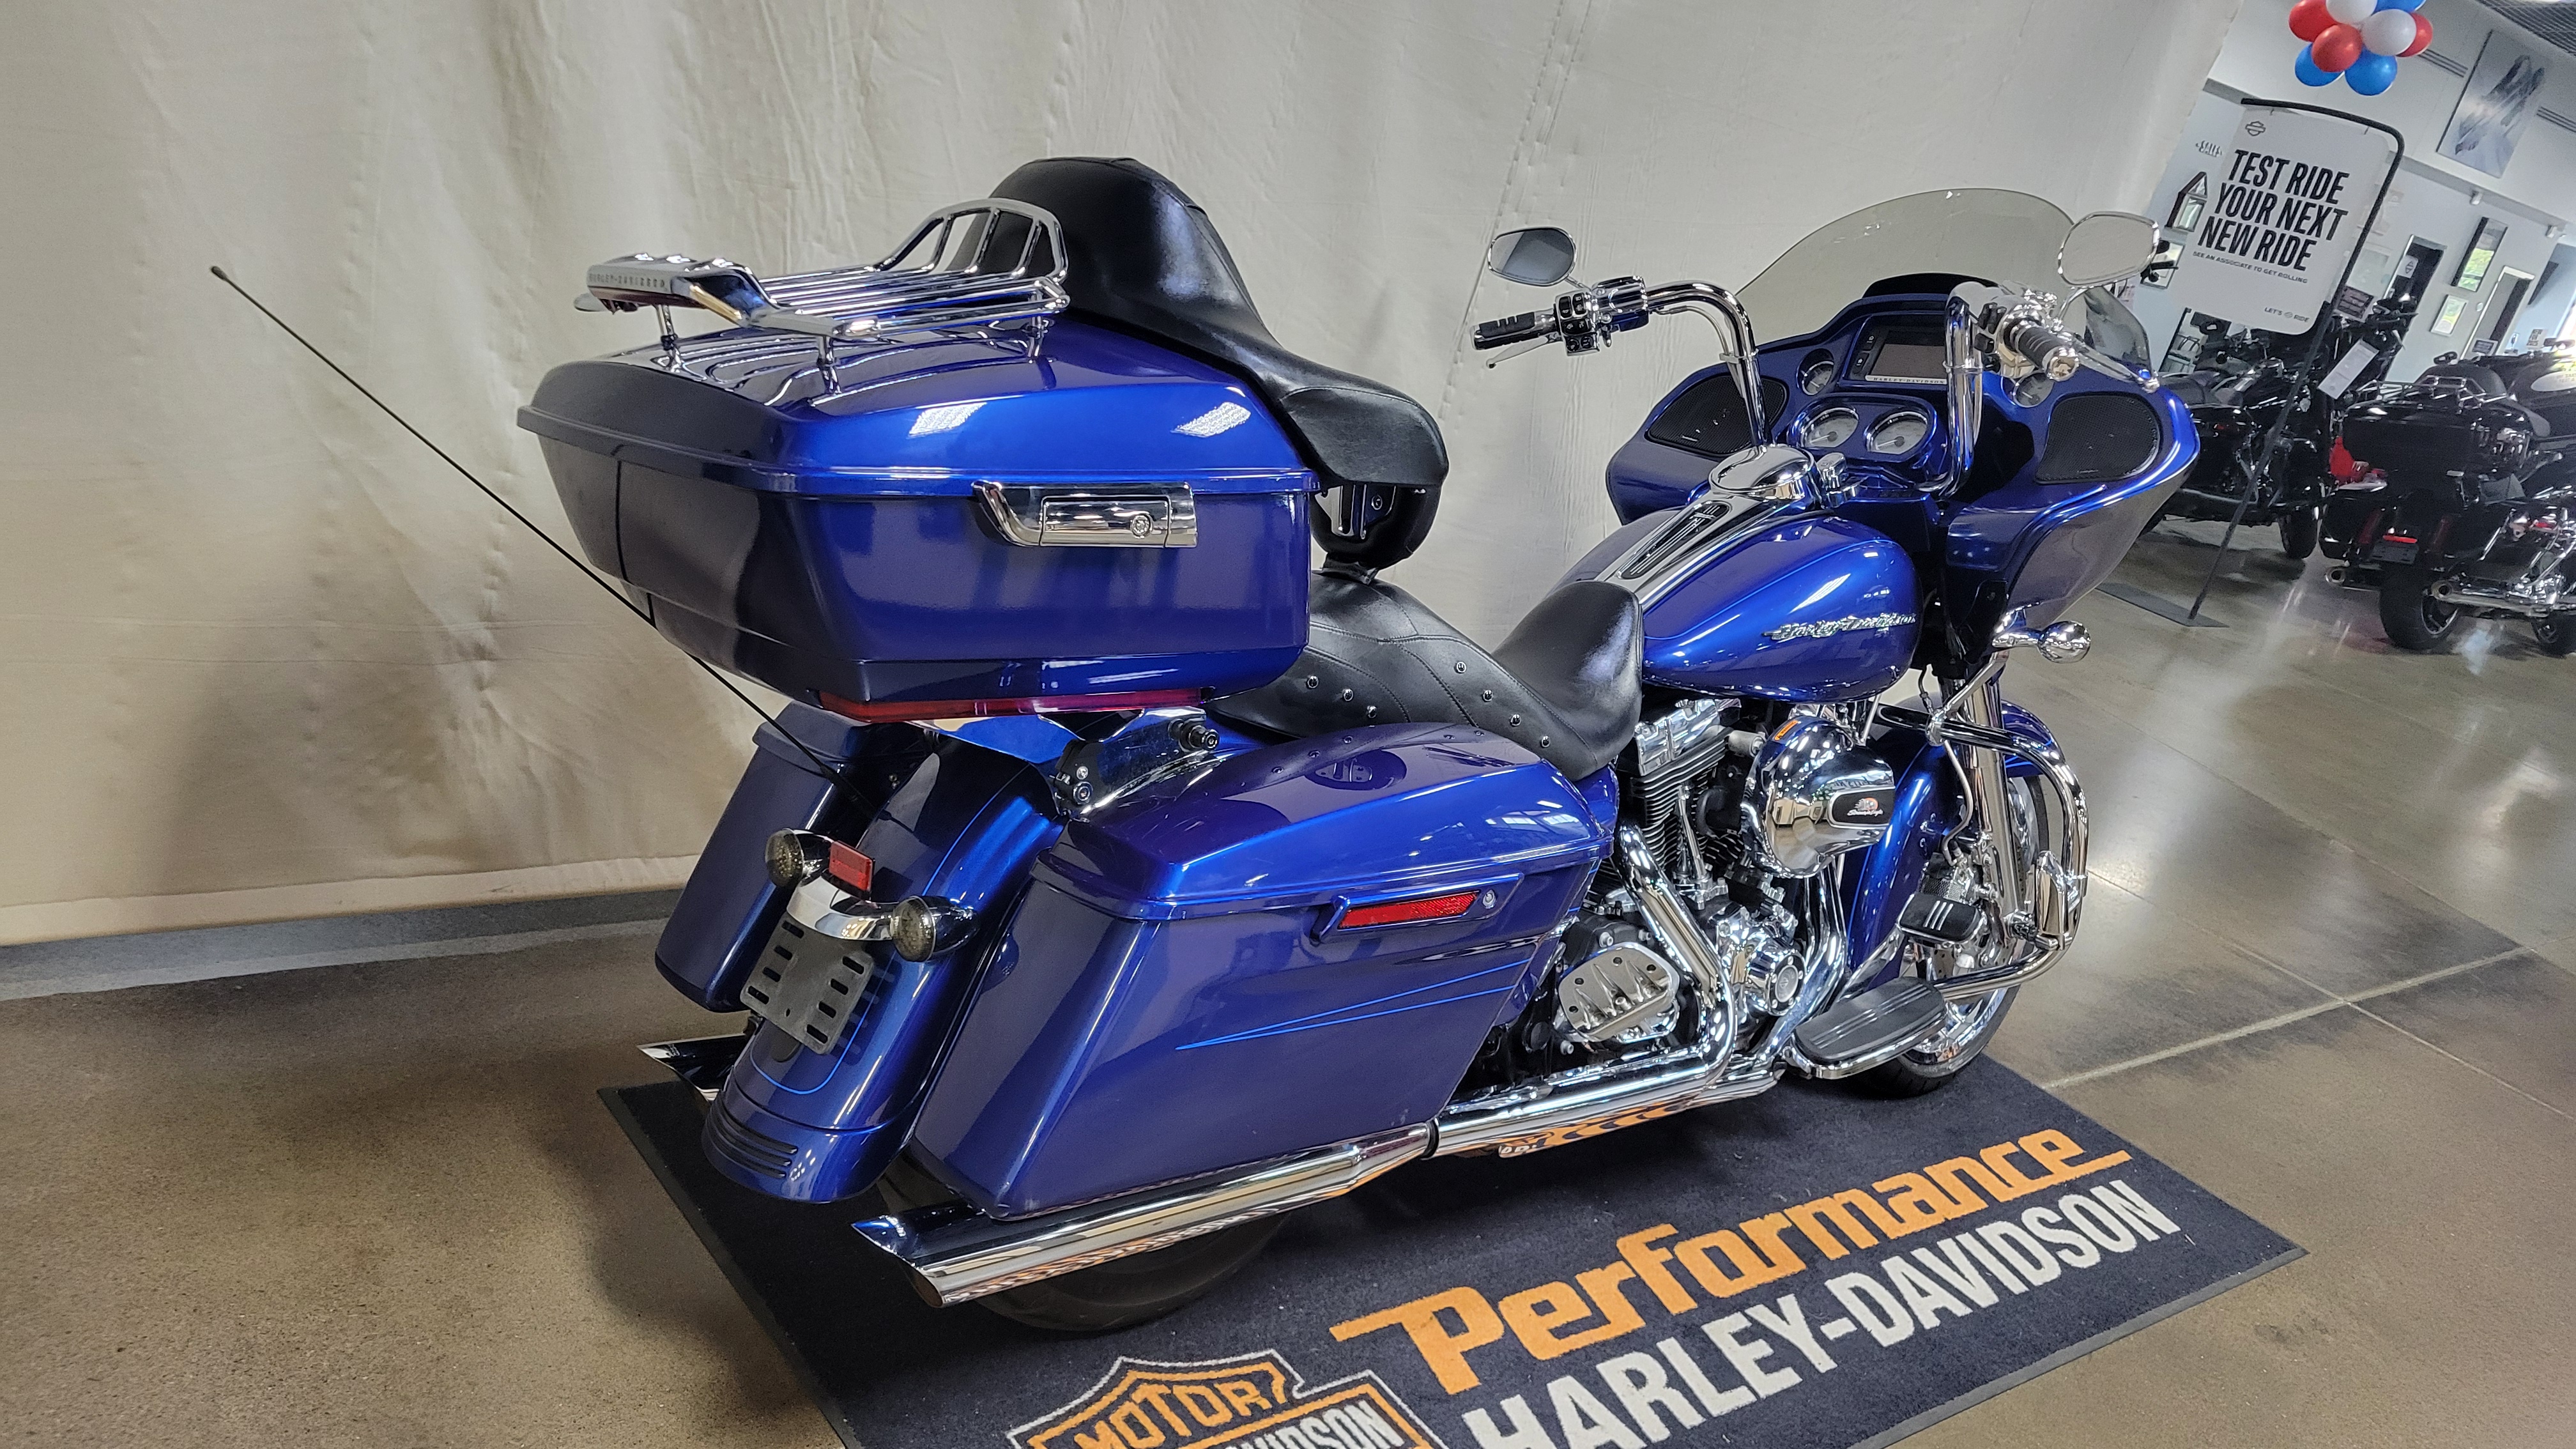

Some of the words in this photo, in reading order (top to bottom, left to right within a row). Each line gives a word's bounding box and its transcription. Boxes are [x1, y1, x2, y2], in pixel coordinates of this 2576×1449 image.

[2228, 149, 2290, 190] TEST
[2285, 162, 2350, 205] RIDE
[2214, 182, 2278, 226] YOUR
[2275, 197, 2349, 241] NEXT
[2198, 216, 2259, 256] NEW
[2253, 229, 2317, 271] RIDE
[2216, 257, 2252, 270] ASSOCIATE
[2278, 272, 2308, 284] ROLLING
[1328, 1128, 2133, 1393] Performance
[1461, 1179, 2181, 1449] HARLEY-DAVIDSON
